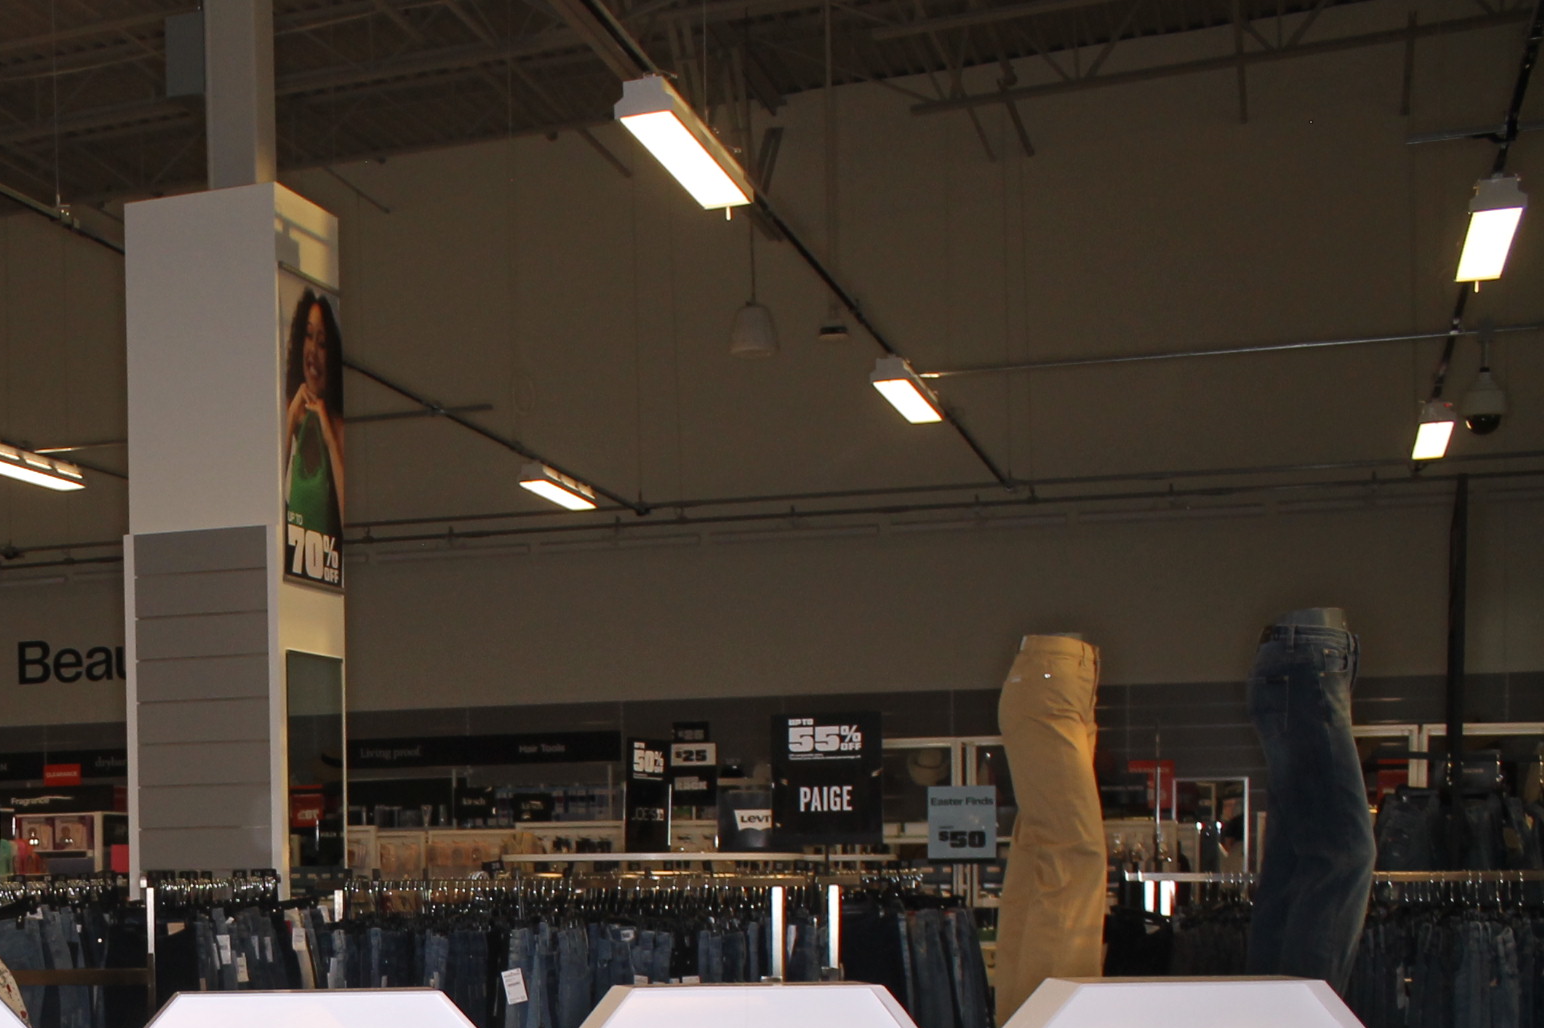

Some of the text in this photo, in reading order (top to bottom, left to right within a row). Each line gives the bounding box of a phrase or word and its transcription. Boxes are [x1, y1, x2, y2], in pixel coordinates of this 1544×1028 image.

[288, 523, 339, 584] 70% OFF
[518, 743, 566, 753] Hair Tools
[788, 725, 862, 752] 55% OFF
[633, 749, 664, 773] 50%
[675, 750, 707, 762] $25
[799, 785, 853, 812] PAIGE
[930, 796, 994, 806] Easter Finds
[939, 831, 986, 848] $50
